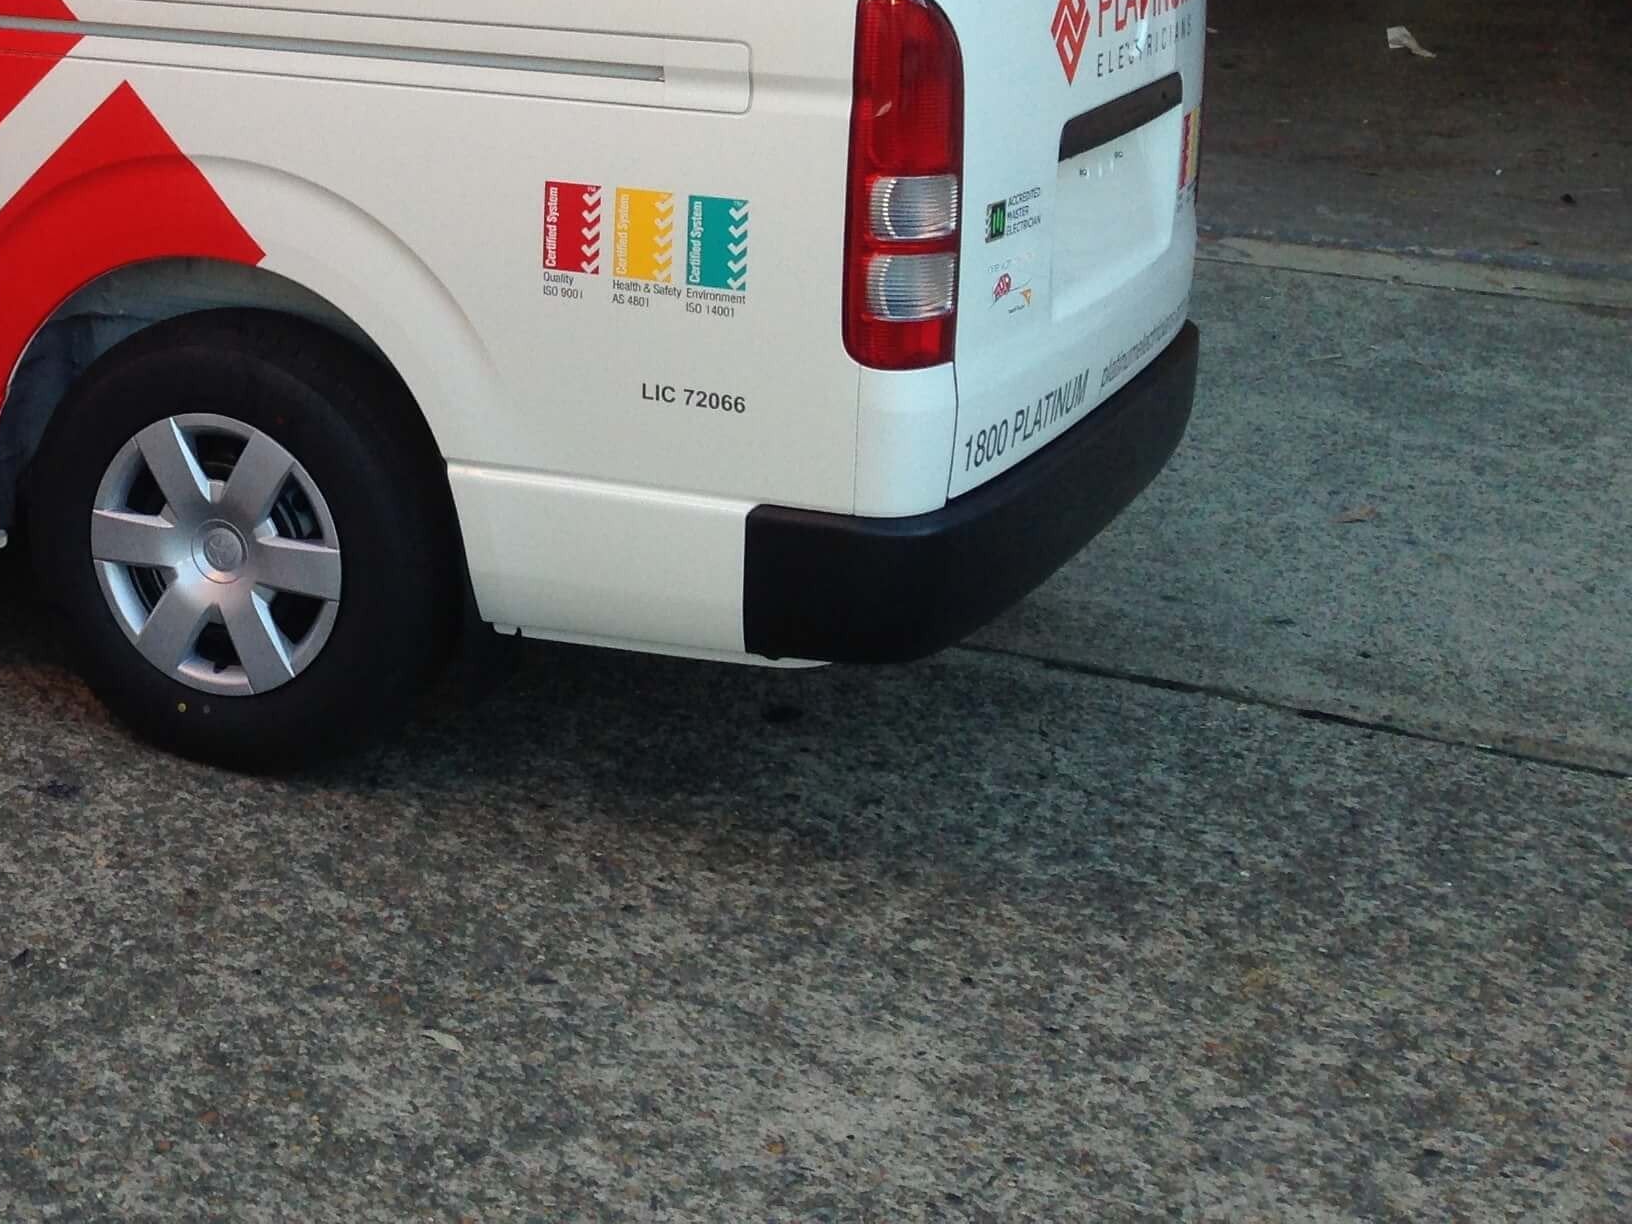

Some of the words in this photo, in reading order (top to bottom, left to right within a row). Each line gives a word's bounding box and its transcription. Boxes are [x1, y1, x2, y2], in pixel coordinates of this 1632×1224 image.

[546, 186, 560, 223] System
[690, 200, 704, 238] System
[545, 225, 558, 268] Certified
[689, 239, 702, 283] Certified
[543, 272, 575, 287] Quality
[543, 285, 559, 296] ISO
[561, 287, 583, 299] 9001
[612, 279, 641, 293] Health
[643, 283, 651, 294] &
[653, 283, 682, 299] Safety
[612, 293, 625, 305] AS
[686, 287, 746, 305] Environment
[686, 302, 702, 314] ISO
[706, 304, 735, 318] 14001
[641, 382, 676, 404] LIC
[683, 388, 747, 414] 72066
[965, 419, 1009, 472] 1800
[1011, 368, 1090, 449] PLATINUM
